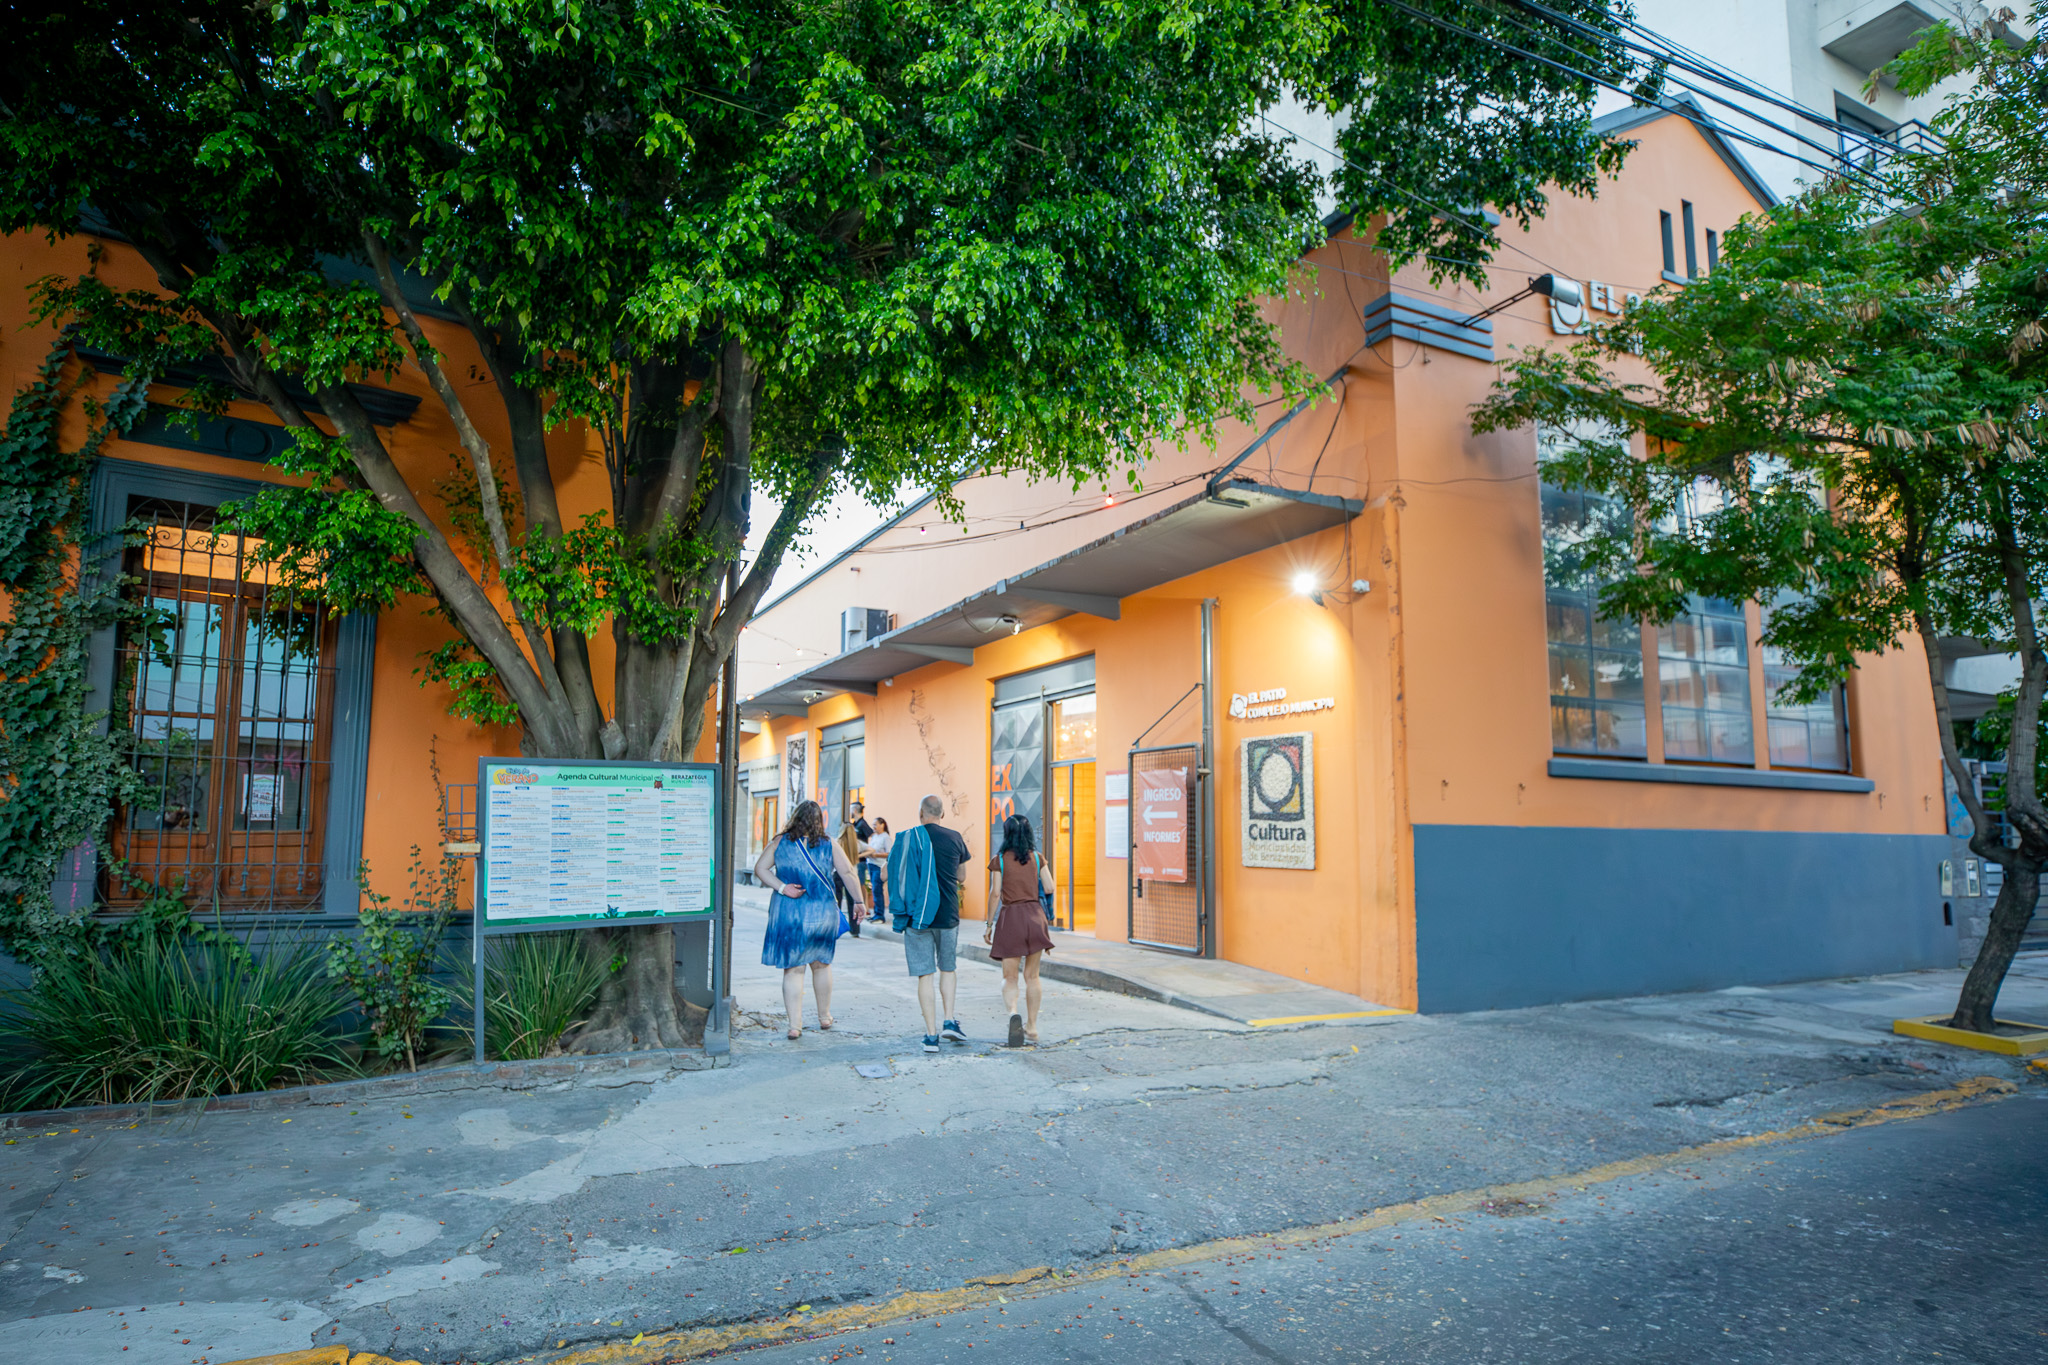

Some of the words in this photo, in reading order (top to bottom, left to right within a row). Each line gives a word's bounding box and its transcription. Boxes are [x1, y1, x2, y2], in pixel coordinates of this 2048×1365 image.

[1590, 279, 1621, 315] EL
[1247, 692, 1260, 704] EL
[1260, 688, 1287, 702] PATIO
[1247, 704, 1290, 719] COMPLEJO
[1290, 697, 1335, 714] MUNICIPAL
[497, 773, 539, 785] VERANO
[557, 773, 587, 781] Agenda
[588, 773, 619, 781] Cultural
[620, 774, 654, 782] Municipal
[991, 763, 1013, 793] EX
[1143, 787, 1182, 802] INGRESO
[1143, 831, 1181, 843] INFORMES
[1248, 823, 1306, 841] Cultura
